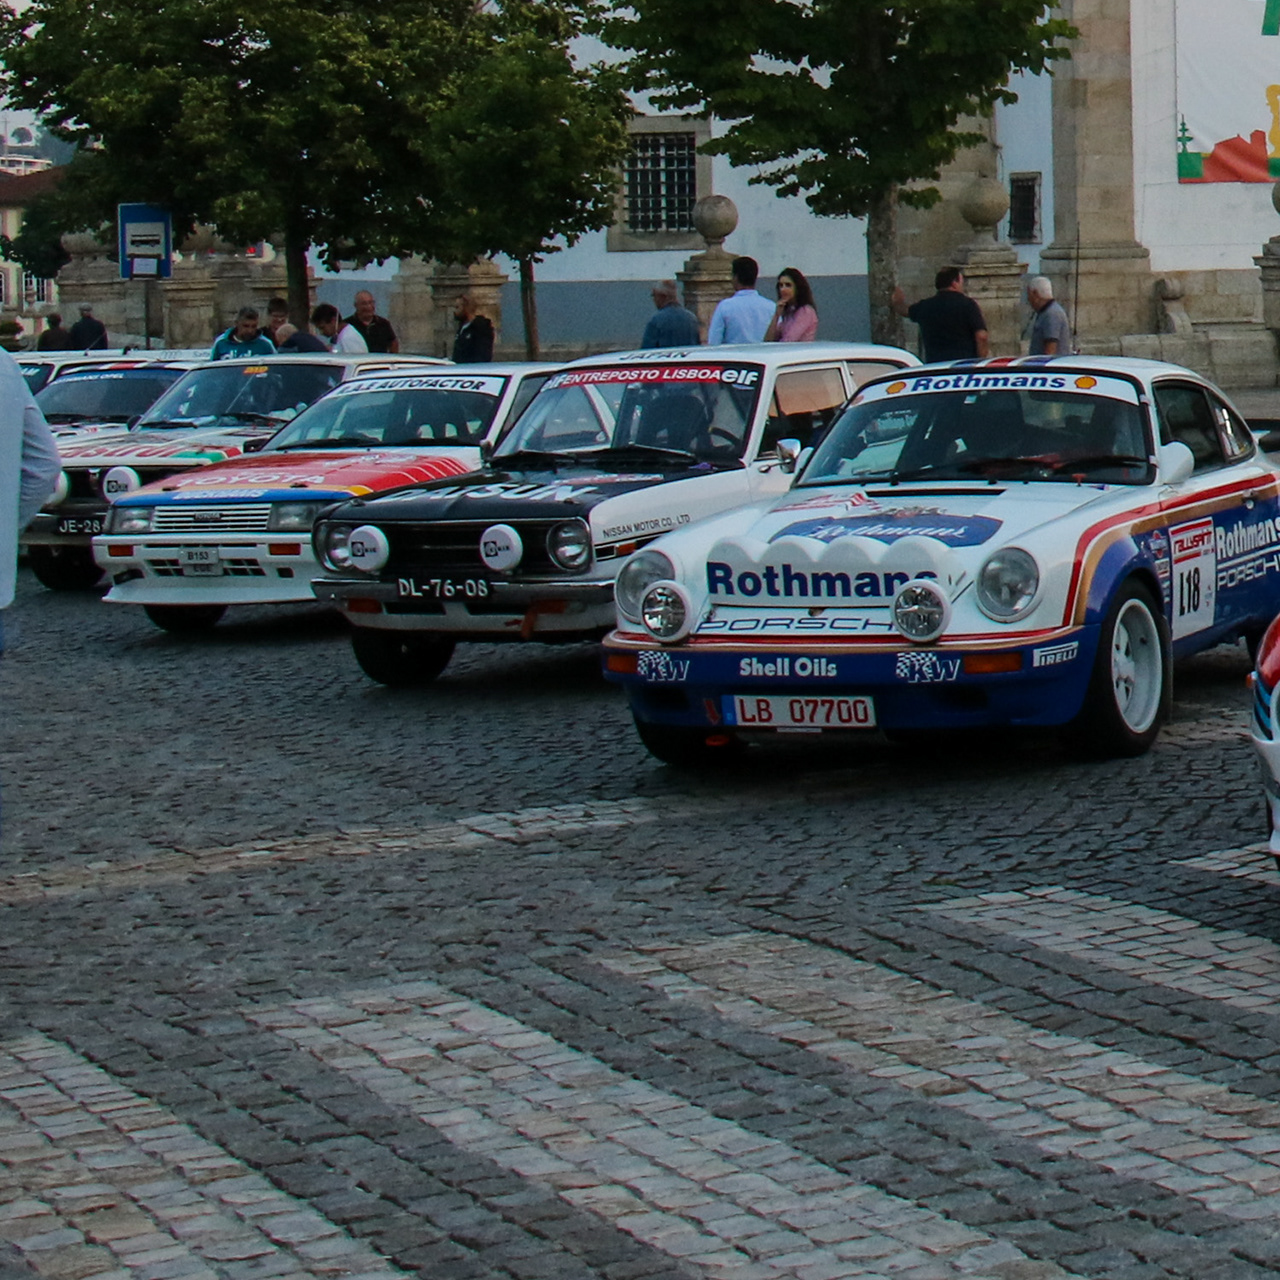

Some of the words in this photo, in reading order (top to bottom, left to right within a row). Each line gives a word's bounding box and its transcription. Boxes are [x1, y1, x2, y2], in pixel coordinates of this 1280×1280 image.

[619, 351, 693, 361] JAPAN
[375, 377, 486, 391] AUTOFACTOR
[564, 369, 660, 385] ENTREPOSTO
[662, 368, 722, 380] LISBOA
[721, 369, 760, 387] elf
[910, 374, 1066, 392] Rothmans
[176, 471, 326, 488] TOYOTA
[376, 483, 599, 504] DATSUN
[59, 520, 101, 534] JE-28
[602, 524, 633, 539] NISSAN
[633, 519, 661, 533] MOTOR
[187, 551, 209, 561] B153
[399, 578, 489, 598] DL-76-08
[696, 617, 894, 634] PORSCH
[1032, 640, 1079, 667] PIRELLI
[739, 656, 790, 677] Shell
[794, 656, 838, 677] Oils
[739, 698, 774, 724] LB
[789, 697, 869, 724] 07700
